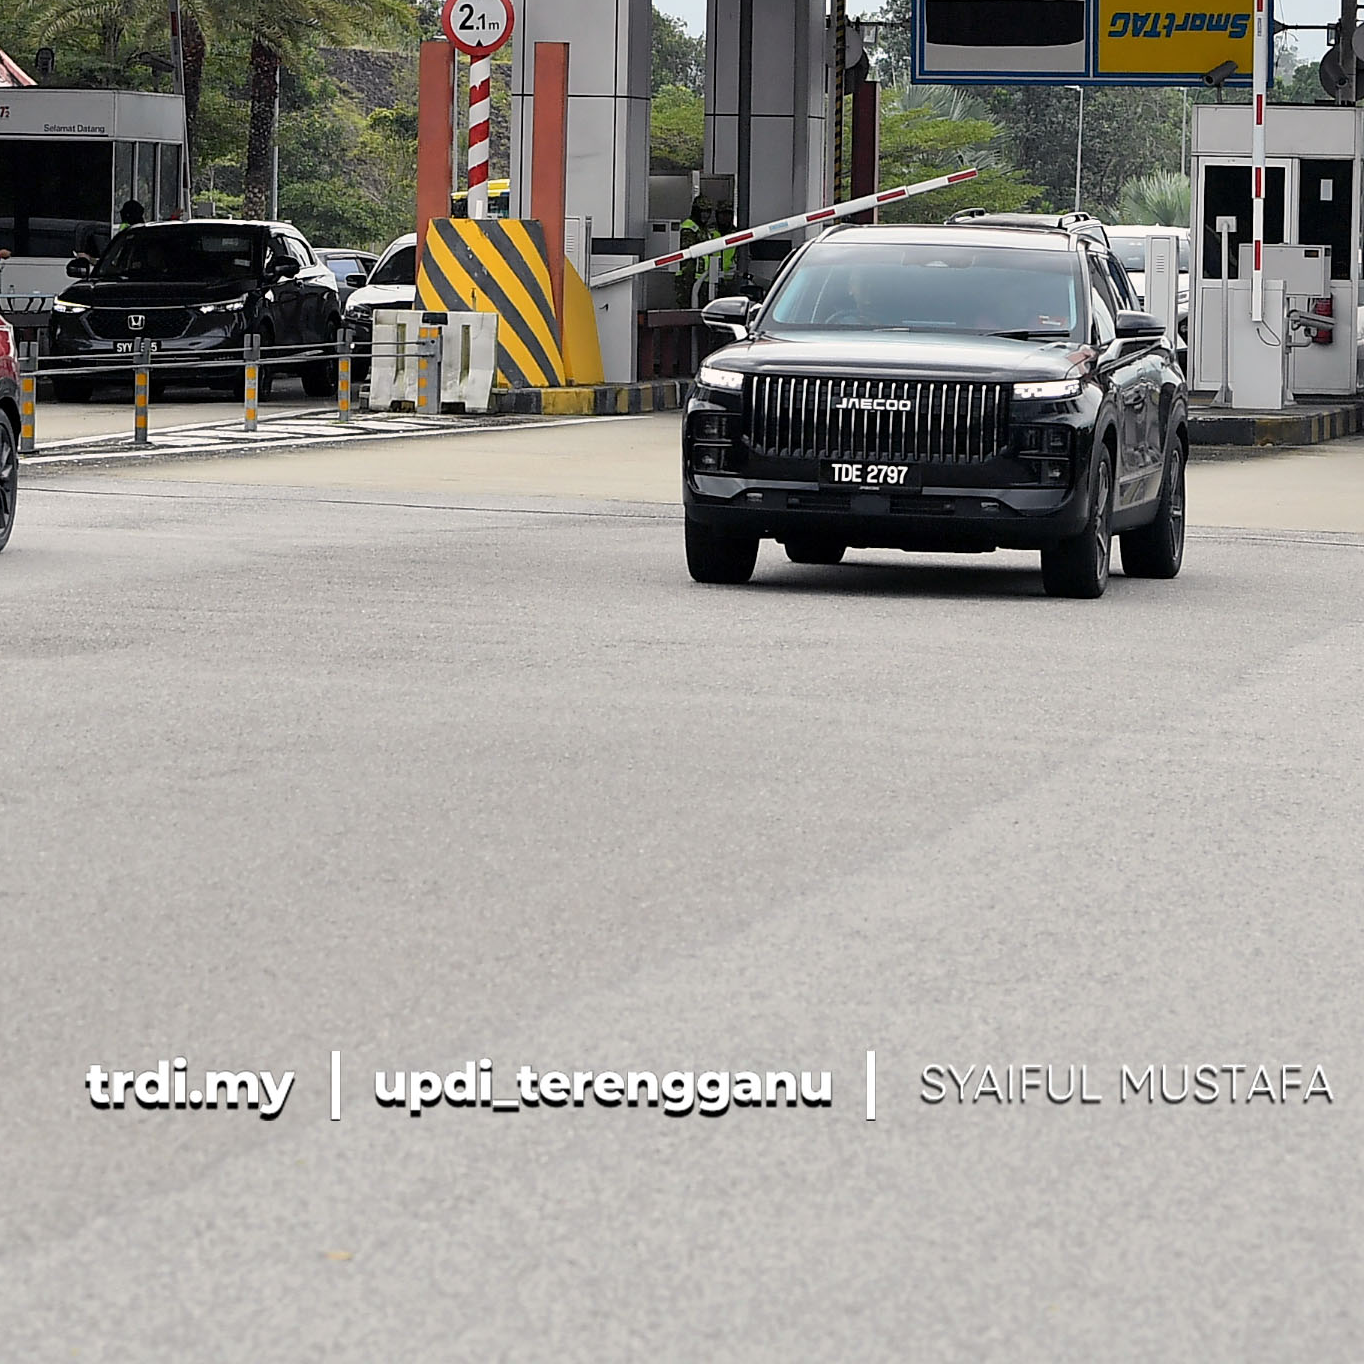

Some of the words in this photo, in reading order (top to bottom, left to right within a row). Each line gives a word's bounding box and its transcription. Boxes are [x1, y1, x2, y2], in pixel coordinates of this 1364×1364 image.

[1108, 12, 1251, 39] SmartTAG
[43, 123, 76, 133] Selamat
[77, 124, 105, 134] Datang
[836, 397, 912, 411] JAECOO
[831, 463, 863, 483] TDE
[866, 464, 908, 484] 2797
